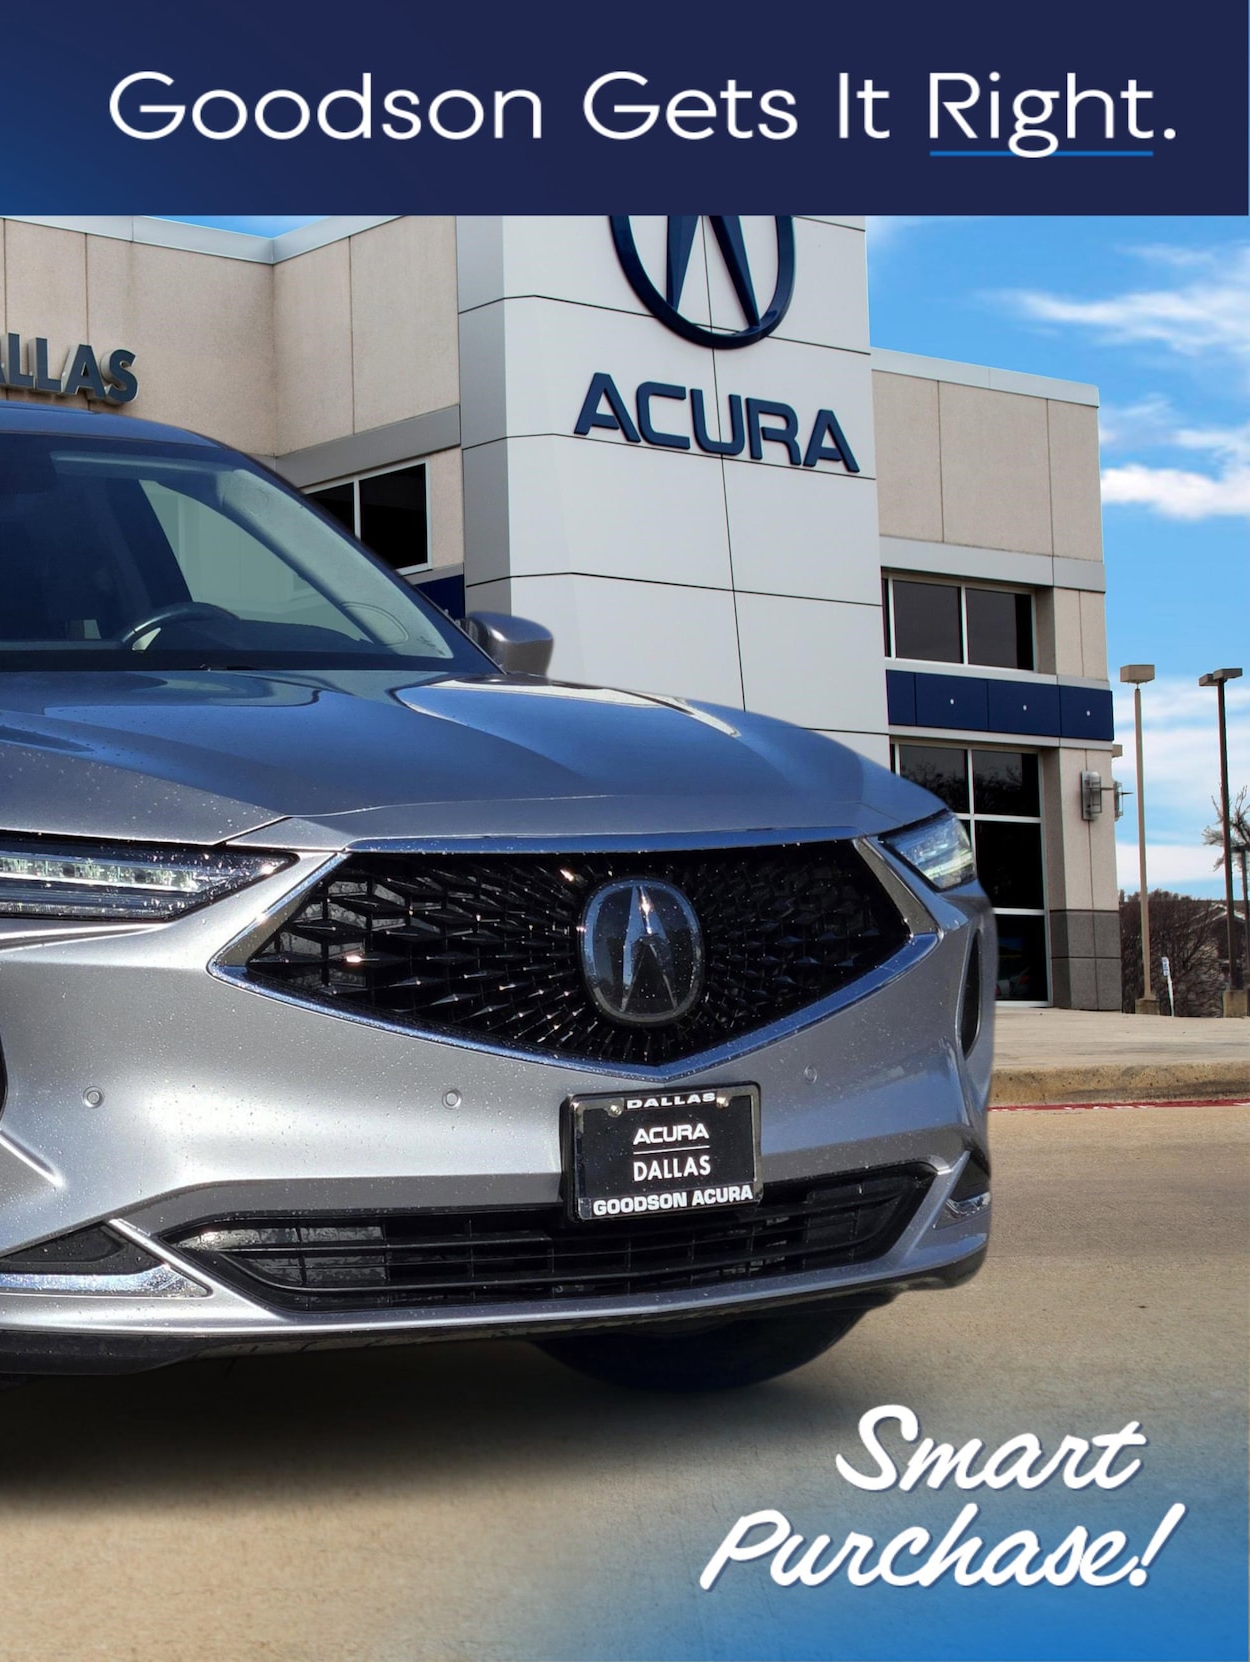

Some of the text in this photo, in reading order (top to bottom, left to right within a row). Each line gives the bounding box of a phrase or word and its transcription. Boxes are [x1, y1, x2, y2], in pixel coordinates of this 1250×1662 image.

[573, 372, 860, 473] ACURA
[626, 1092, 716, 1109] DALLAS
[633, 1123, 709, 1145] ACURA
[633, 1155, 711, 1182] DALLAS
[593, 1185, 753, 1216] GOODSON ACURA
